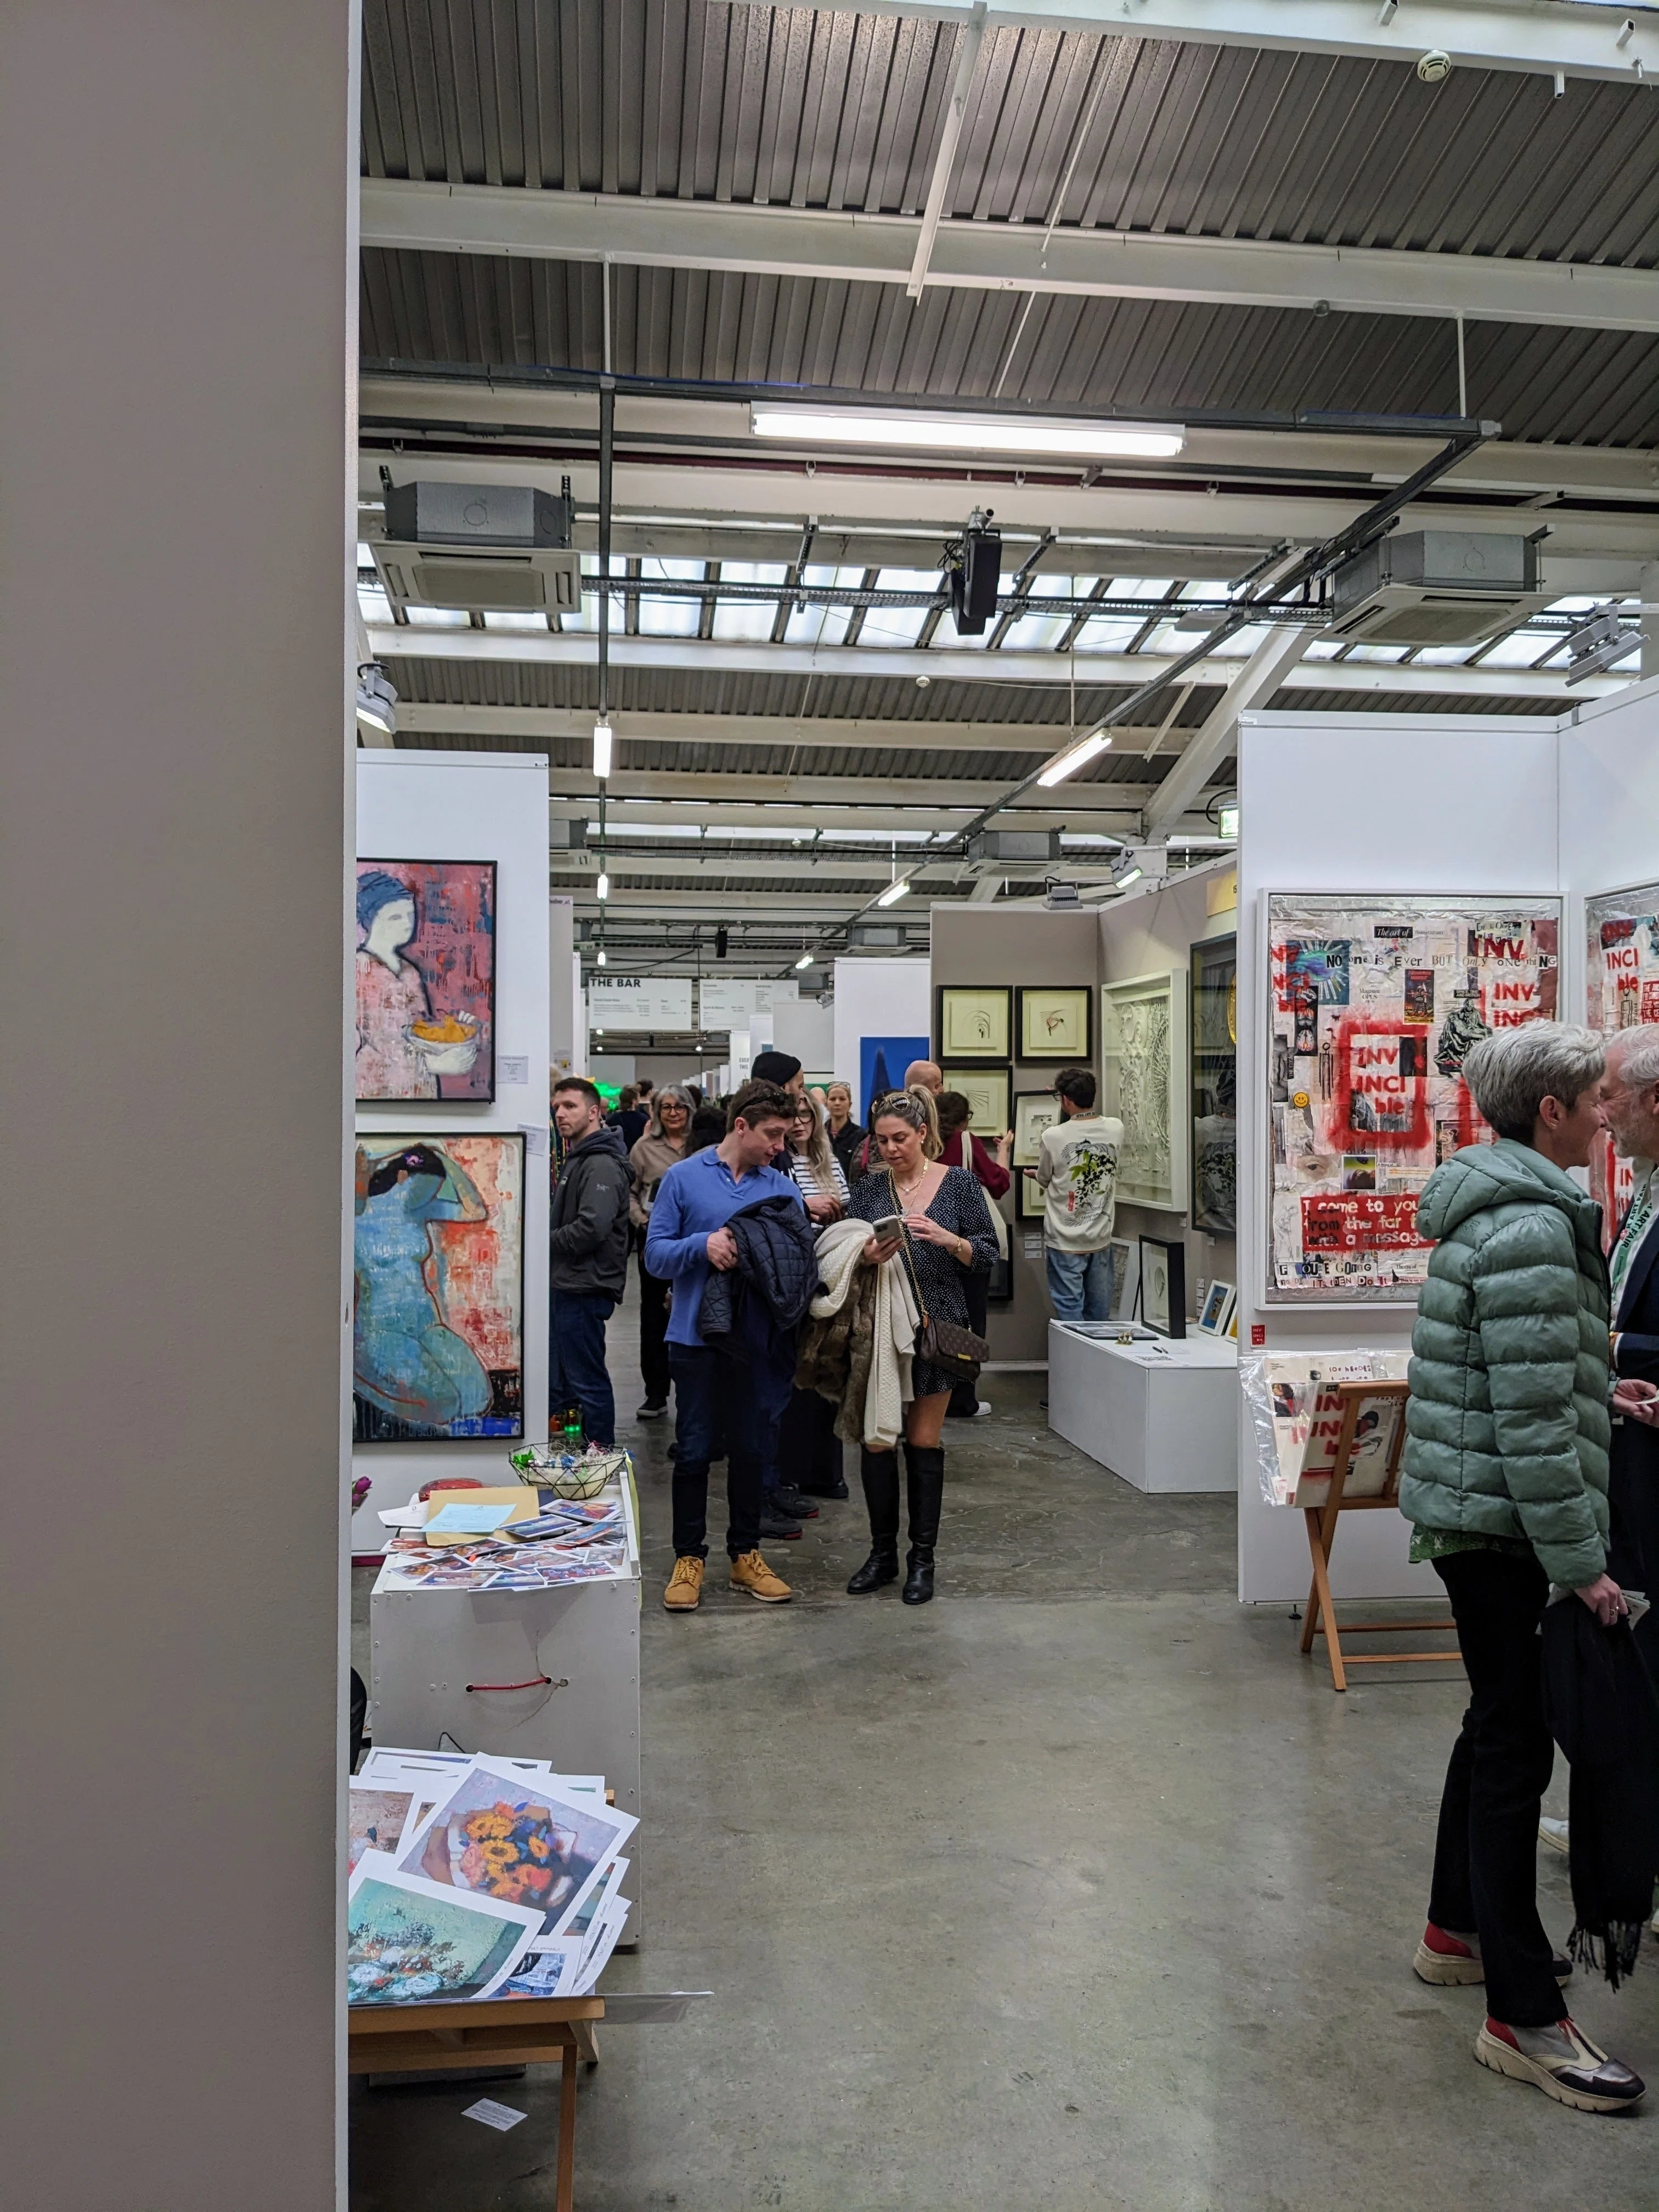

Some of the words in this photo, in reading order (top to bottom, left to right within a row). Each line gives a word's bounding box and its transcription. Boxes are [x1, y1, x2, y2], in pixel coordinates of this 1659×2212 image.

[1376, 928, 1389, 936] The
[1389, 928, 1400, 936] art
[1402, 927, 1411, 937] of
[1326, 955, 1342, 968] NO
[1374, 955, 1384, 966] is
[1431, 955, 1453, 966] BUT
[1606, 947, 1639, 970] INCI
[590, 978, 613, 988] THE
[617, 978, 641, 988] BAR
[1617, 972, 1639, 991] ble
[1494, 983, 1535, 1001] INV
[1357, 1047, 1399, 1065] INV
[1356, 1075, 1406, 1093] INCI
[1375, 1097, 1405, 1115] ble
[1317, 1200, 1359, 1214] come
[1365, 1198, 1384, 1213] to
[1344, 1216, 1373, 1230] the
[1379, 1215, 1402, 1229] far
[1634, 1209, 1650, 1229] ART
[1345, 1234, 1356, 1246] a
[1621, 1228, 1639, 1248] FAIR
